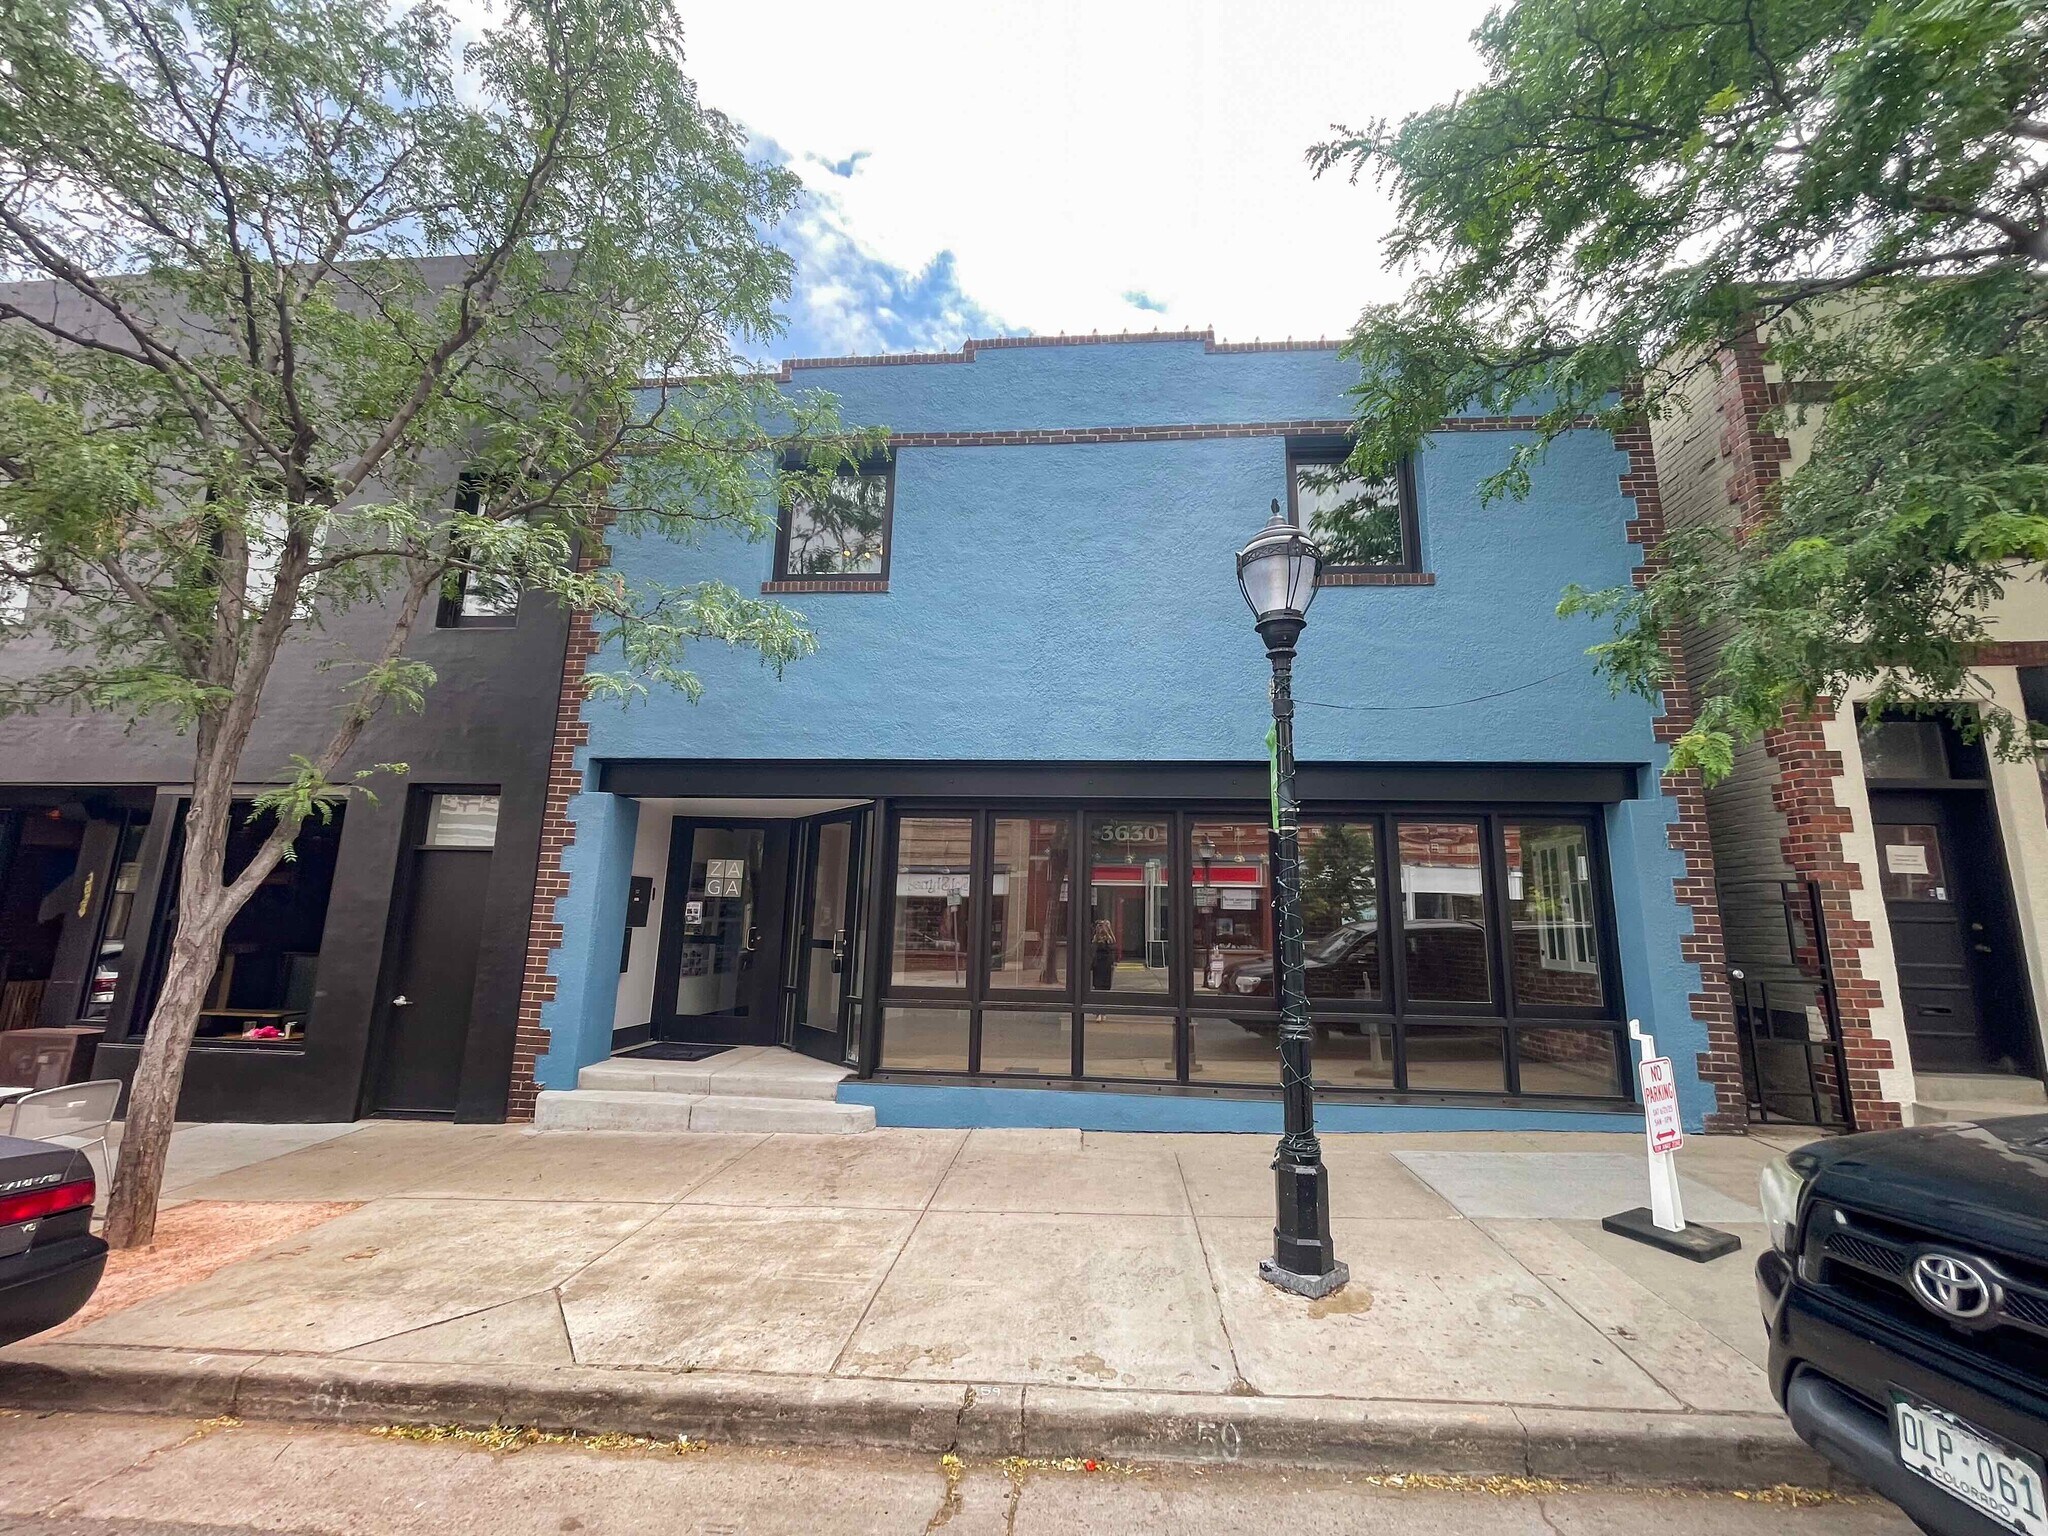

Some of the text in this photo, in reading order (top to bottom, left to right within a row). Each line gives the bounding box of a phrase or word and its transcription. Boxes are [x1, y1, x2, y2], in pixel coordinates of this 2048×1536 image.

[1101, 825, 1159, 842] 3630
[1650, 1065, 1663, 1082] NO
[1645, 1082, 1674, 1104] PARKING
[1934, 1466, 2011, 1518] COLORADO
